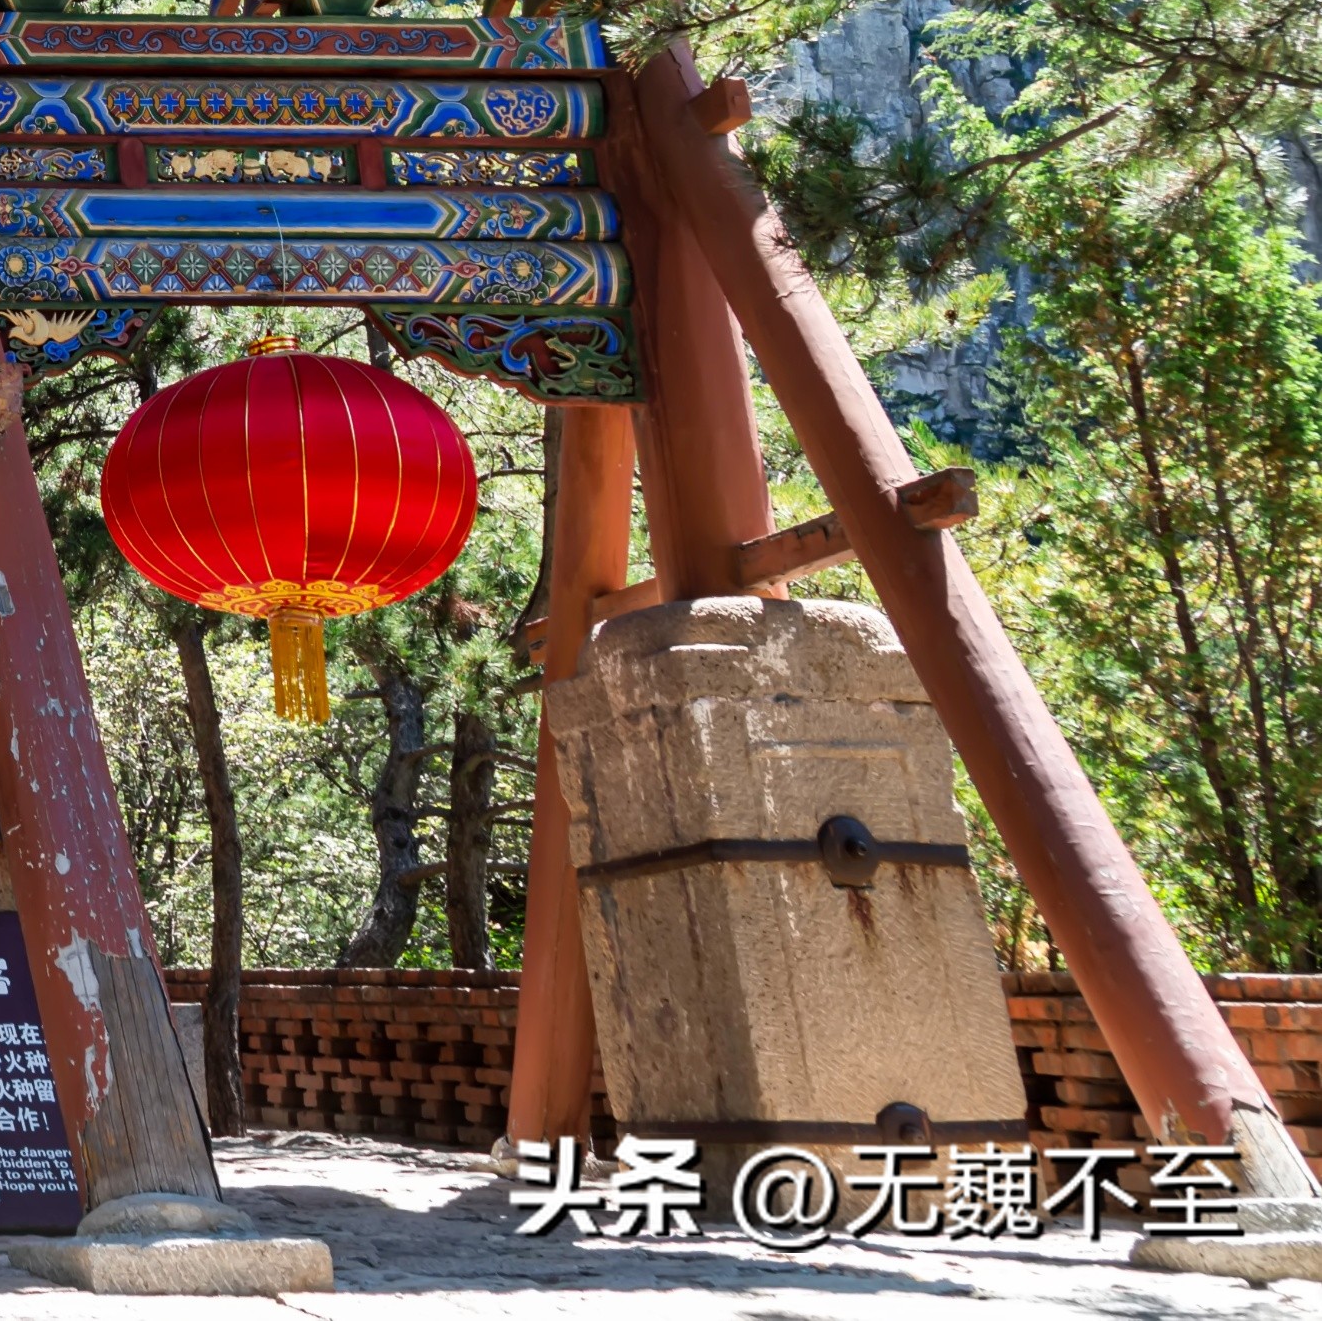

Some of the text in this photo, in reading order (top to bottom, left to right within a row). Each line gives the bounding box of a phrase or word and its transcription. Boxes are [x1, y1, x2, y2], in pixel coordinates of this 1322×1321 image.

[53, 1159, 69, 1169] to
[6, 1169, 21, 1179] to
[24, 1169, 58, 1180] visit.
[60, 1169, 77, 1180] Pl
[38, 1182, 66, 1194] you
